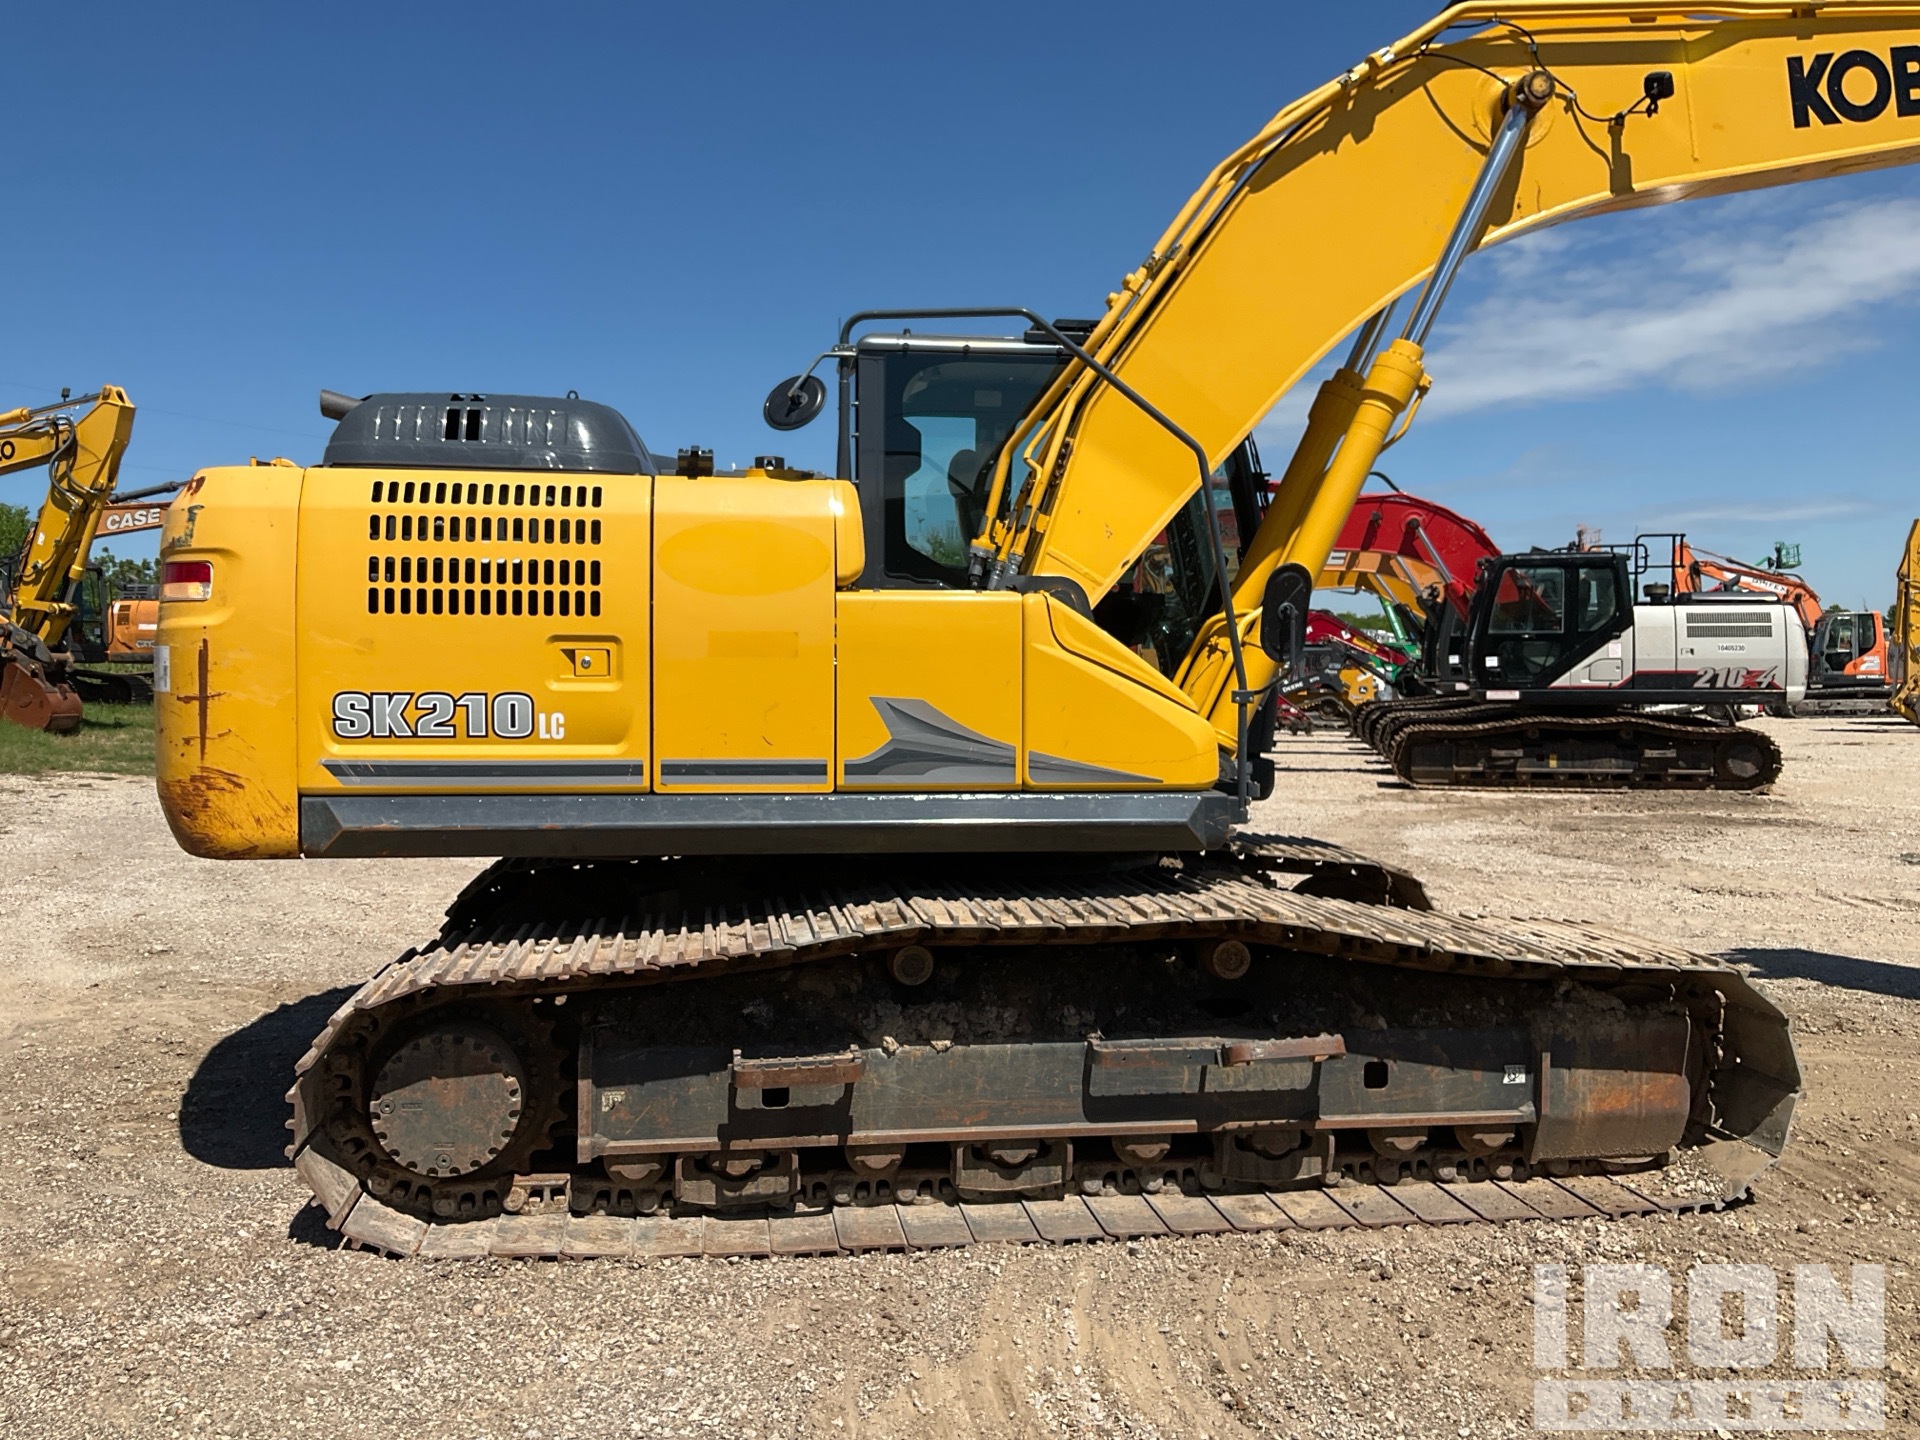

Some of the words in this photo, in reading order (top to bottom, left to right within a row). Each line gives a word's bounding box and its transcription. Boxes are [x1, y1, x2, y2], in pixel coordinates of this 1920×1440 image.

[106, 508, 161, 530] CASE
[1282, 681, 1304, 693] DEERE
[332, 691, 535, 738] SK210
[538, 712, 565, 739] LC
